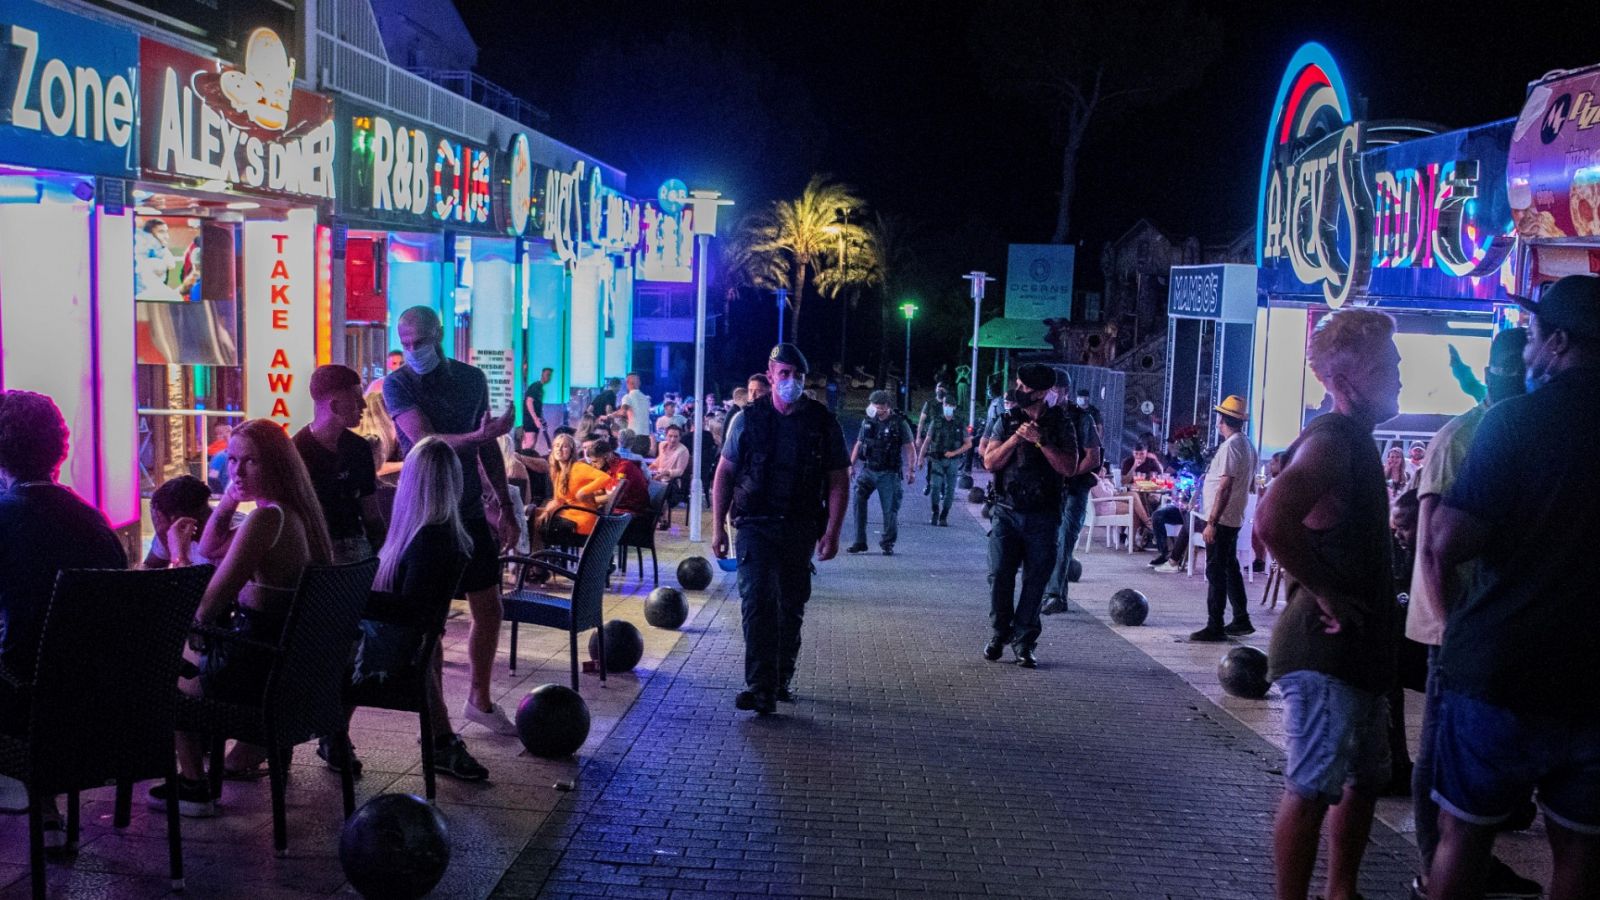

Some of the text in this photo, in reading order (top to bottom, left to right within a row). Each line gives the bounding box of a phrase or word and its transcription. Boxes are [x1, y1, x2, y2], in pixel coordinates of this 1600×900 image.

[12, 25, 134, 147] Zone
[157, 66, 336, 198] ALEX'S DINER
[373, 117, 429, 214] R&B
[271, 234, 290, 330] TAKE
[268, 348, 293, 432] AWA
